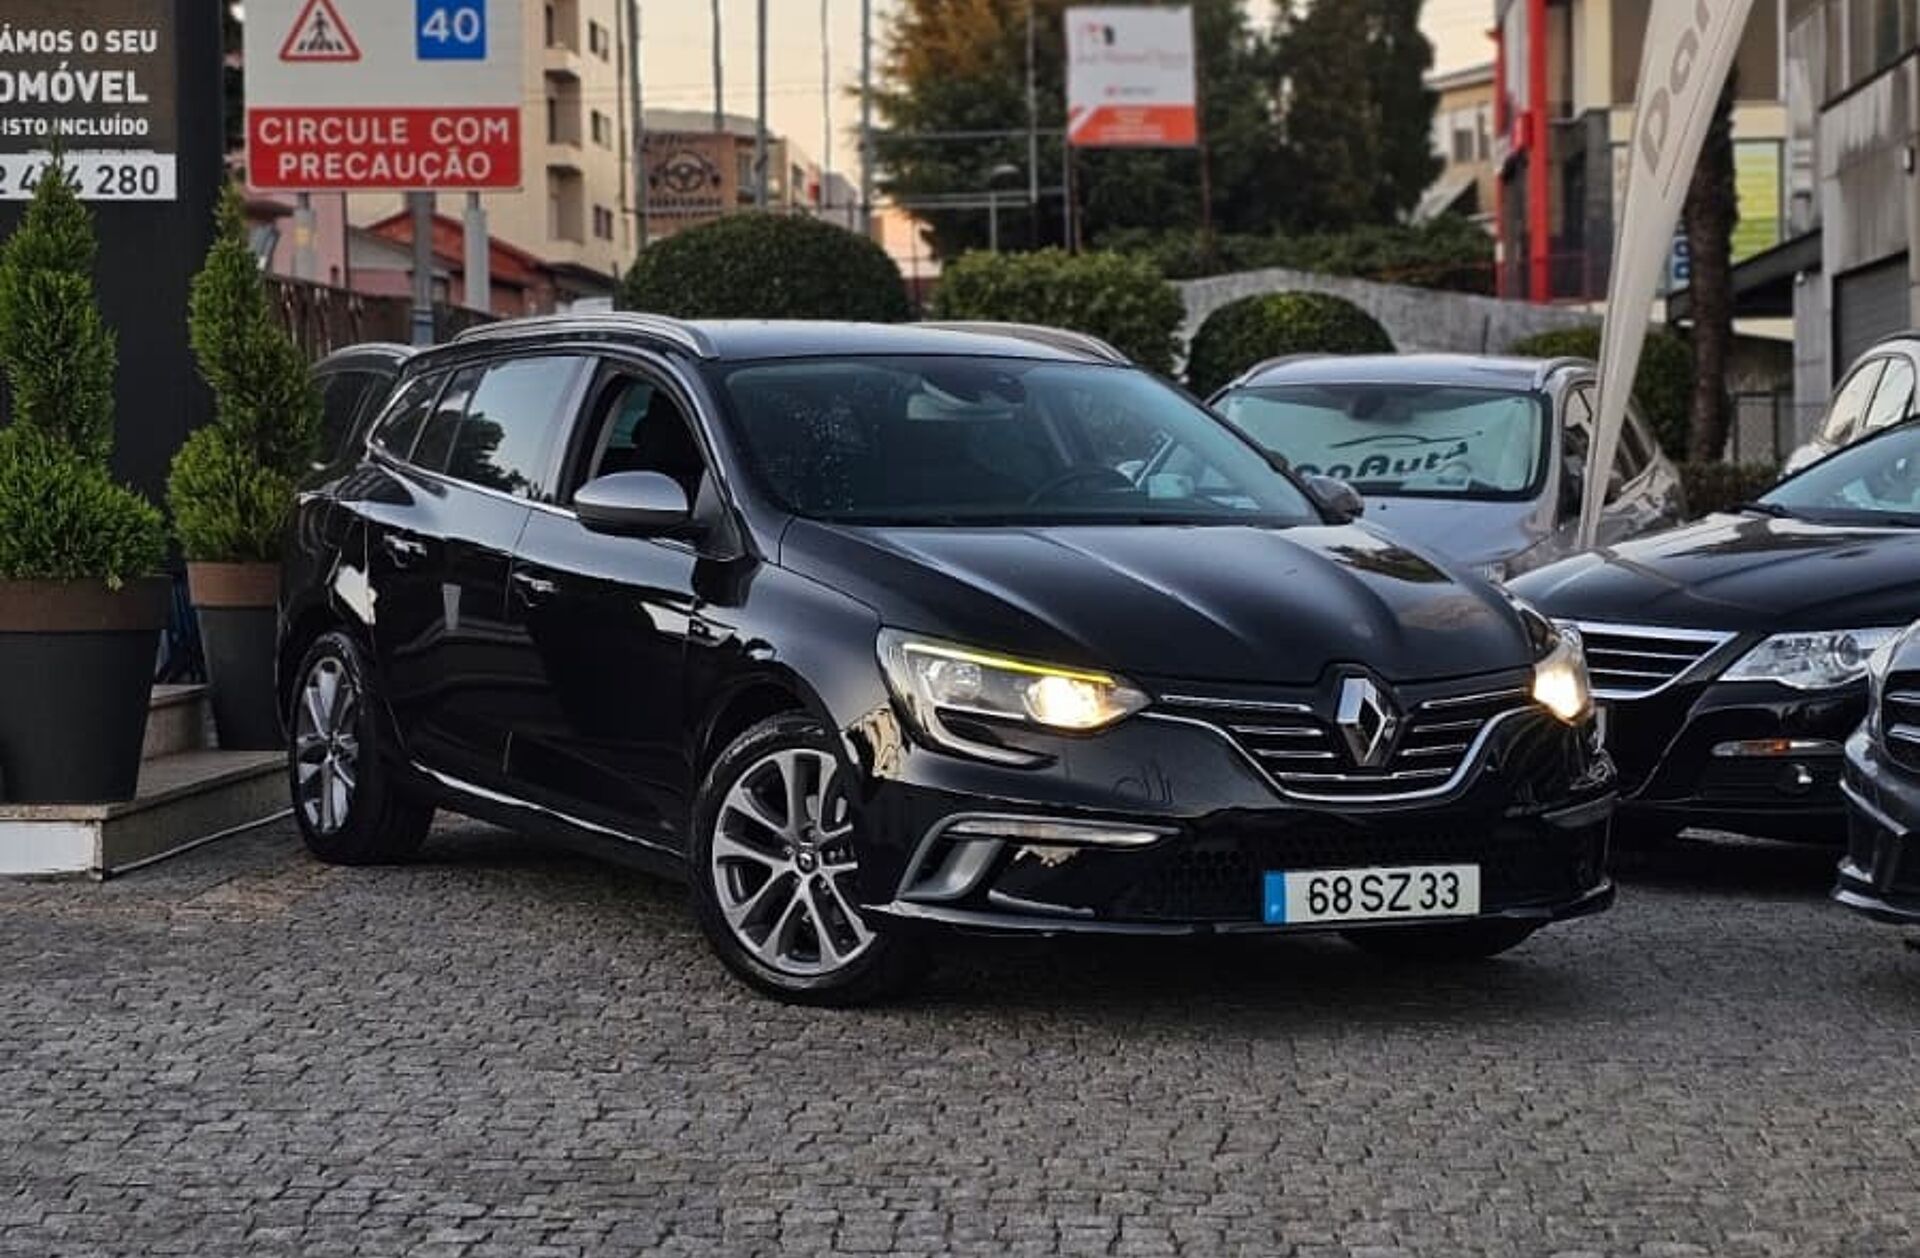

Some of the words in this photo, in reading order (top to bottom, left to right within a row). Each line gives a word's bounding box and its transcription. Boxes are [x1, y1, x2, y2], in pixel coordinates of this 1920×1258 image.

[422, 8, 480, 43] 40
[80, 30, 99, 53] O
[105, 30, 158, 53] SEU
[52, 112, 149, 136] INCLUÍDO
[258, 117, 409, 145] CIRCULE
[430, 117, 510, 145] COM
[96, 164, 159, 195] 280
[278, 147, 491, 184] PRECAUÇÃO
